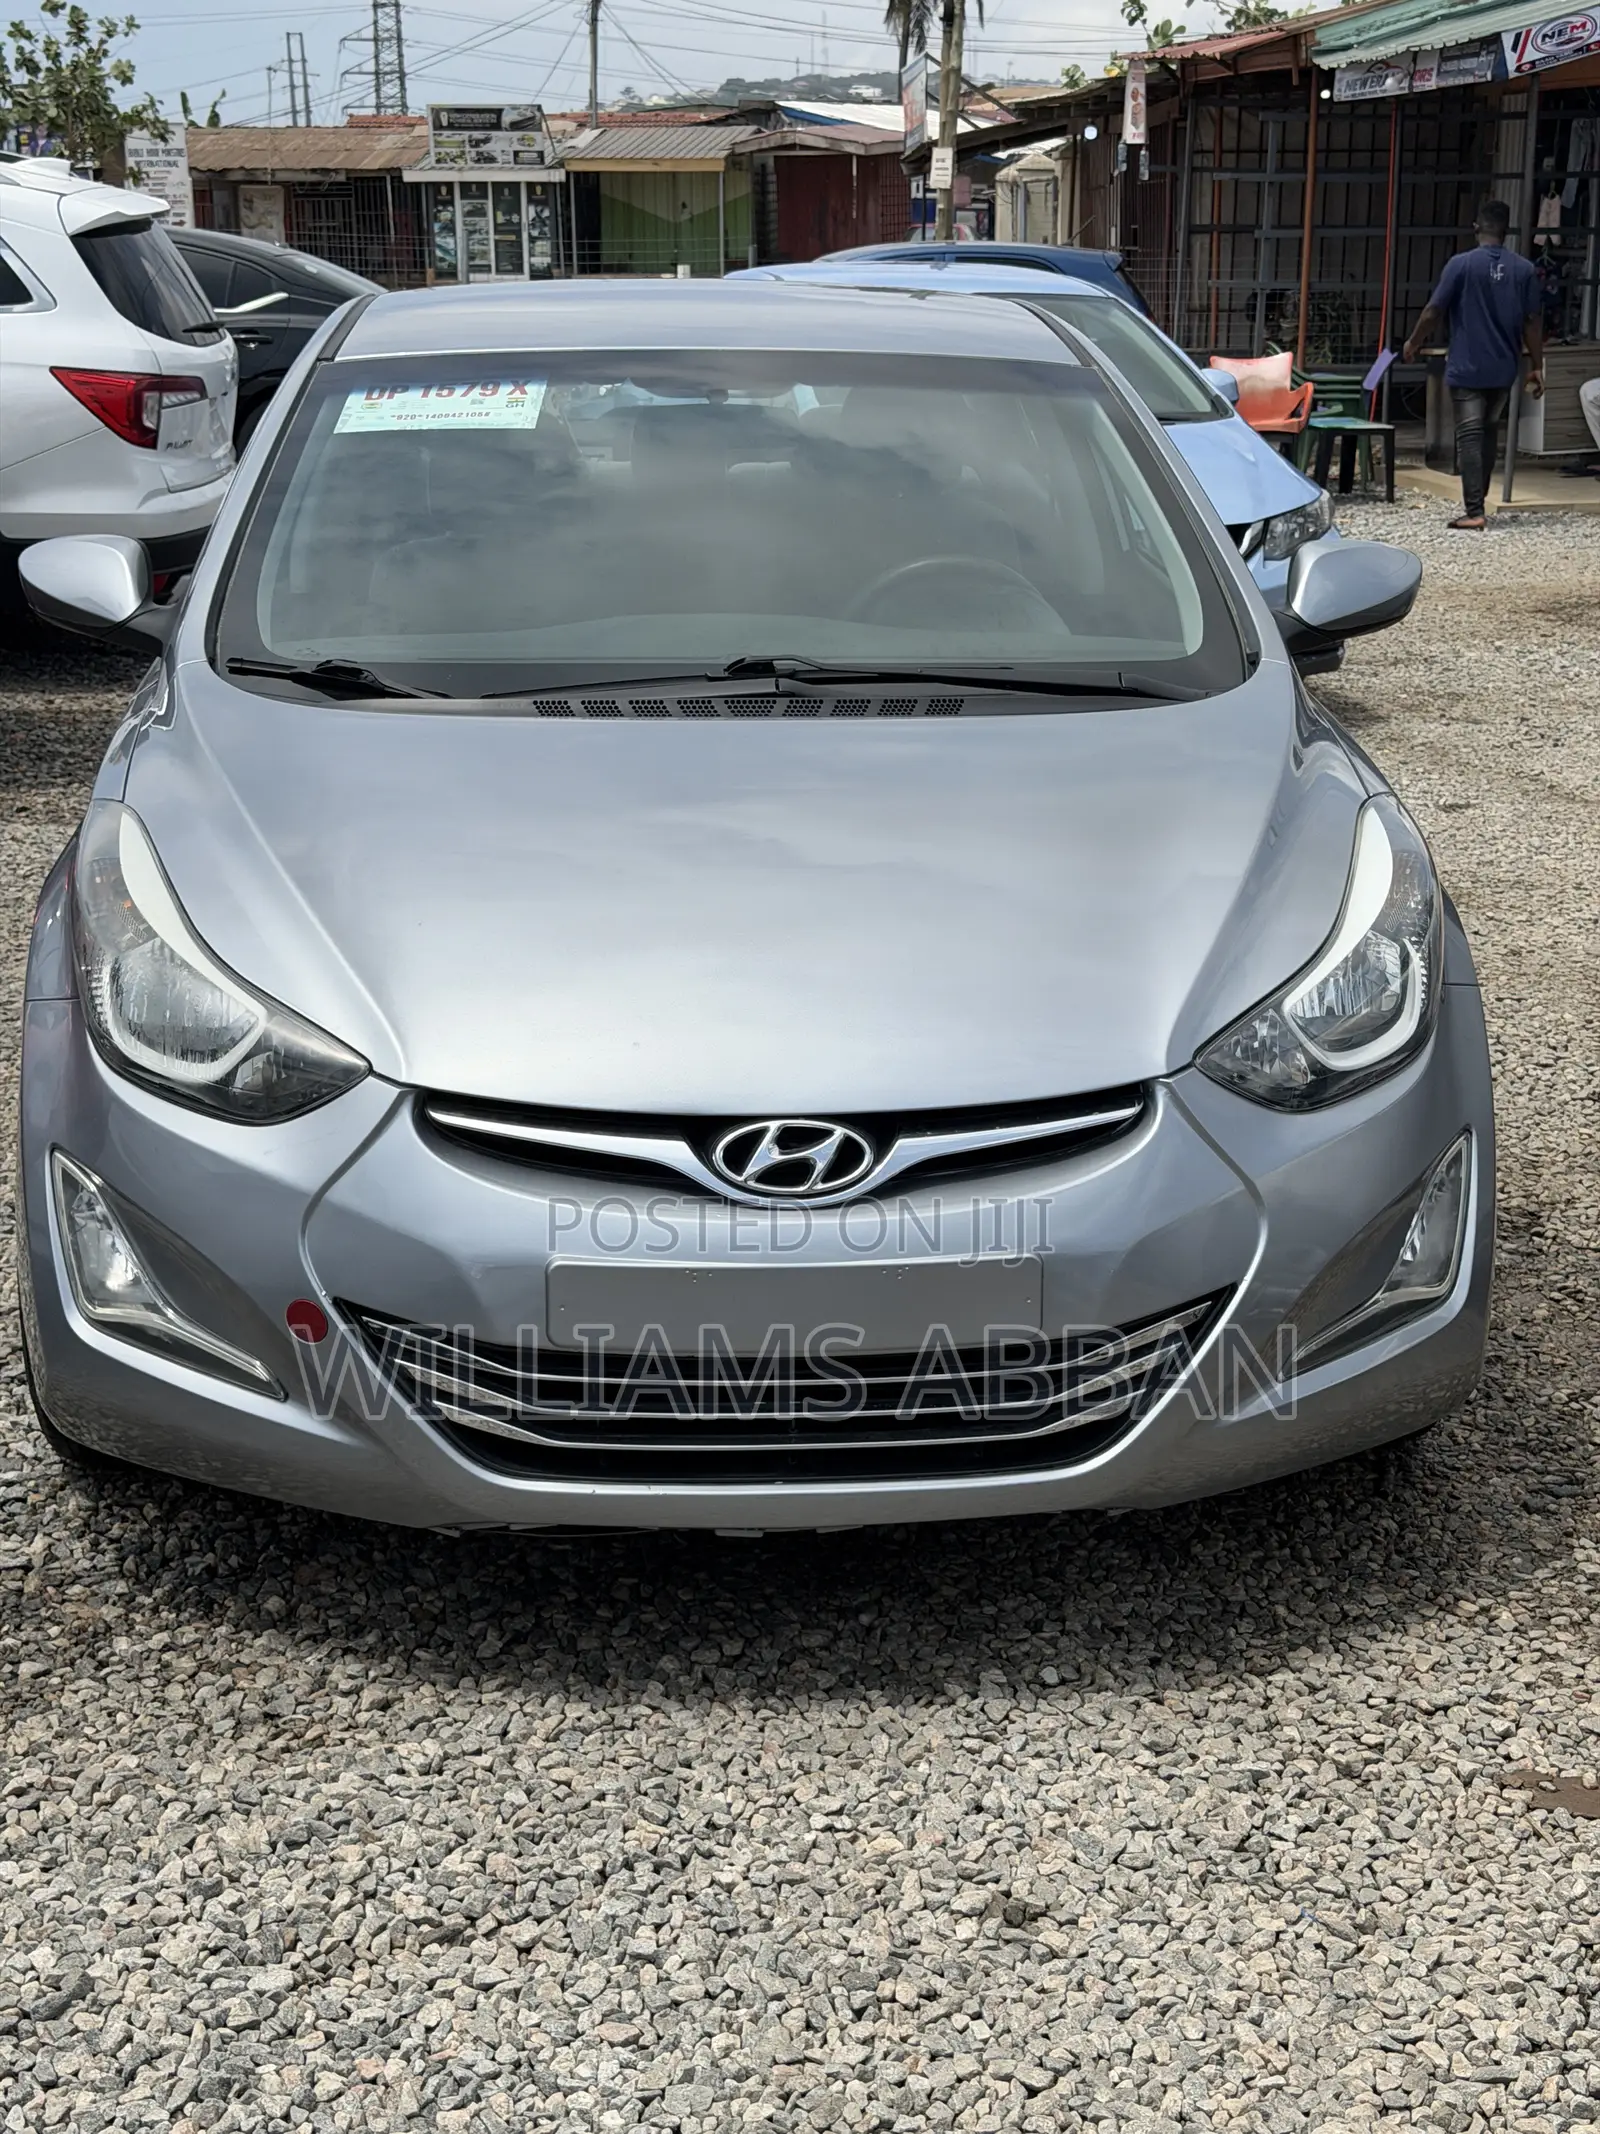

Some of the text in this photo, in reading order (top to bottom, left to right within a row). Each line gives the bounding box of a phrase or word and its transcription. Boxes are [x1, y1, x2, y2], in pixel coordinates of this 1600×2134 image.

[1541, 21, 1588, 42] NEM
[364, 380, 531, 401] DP 1579 X
